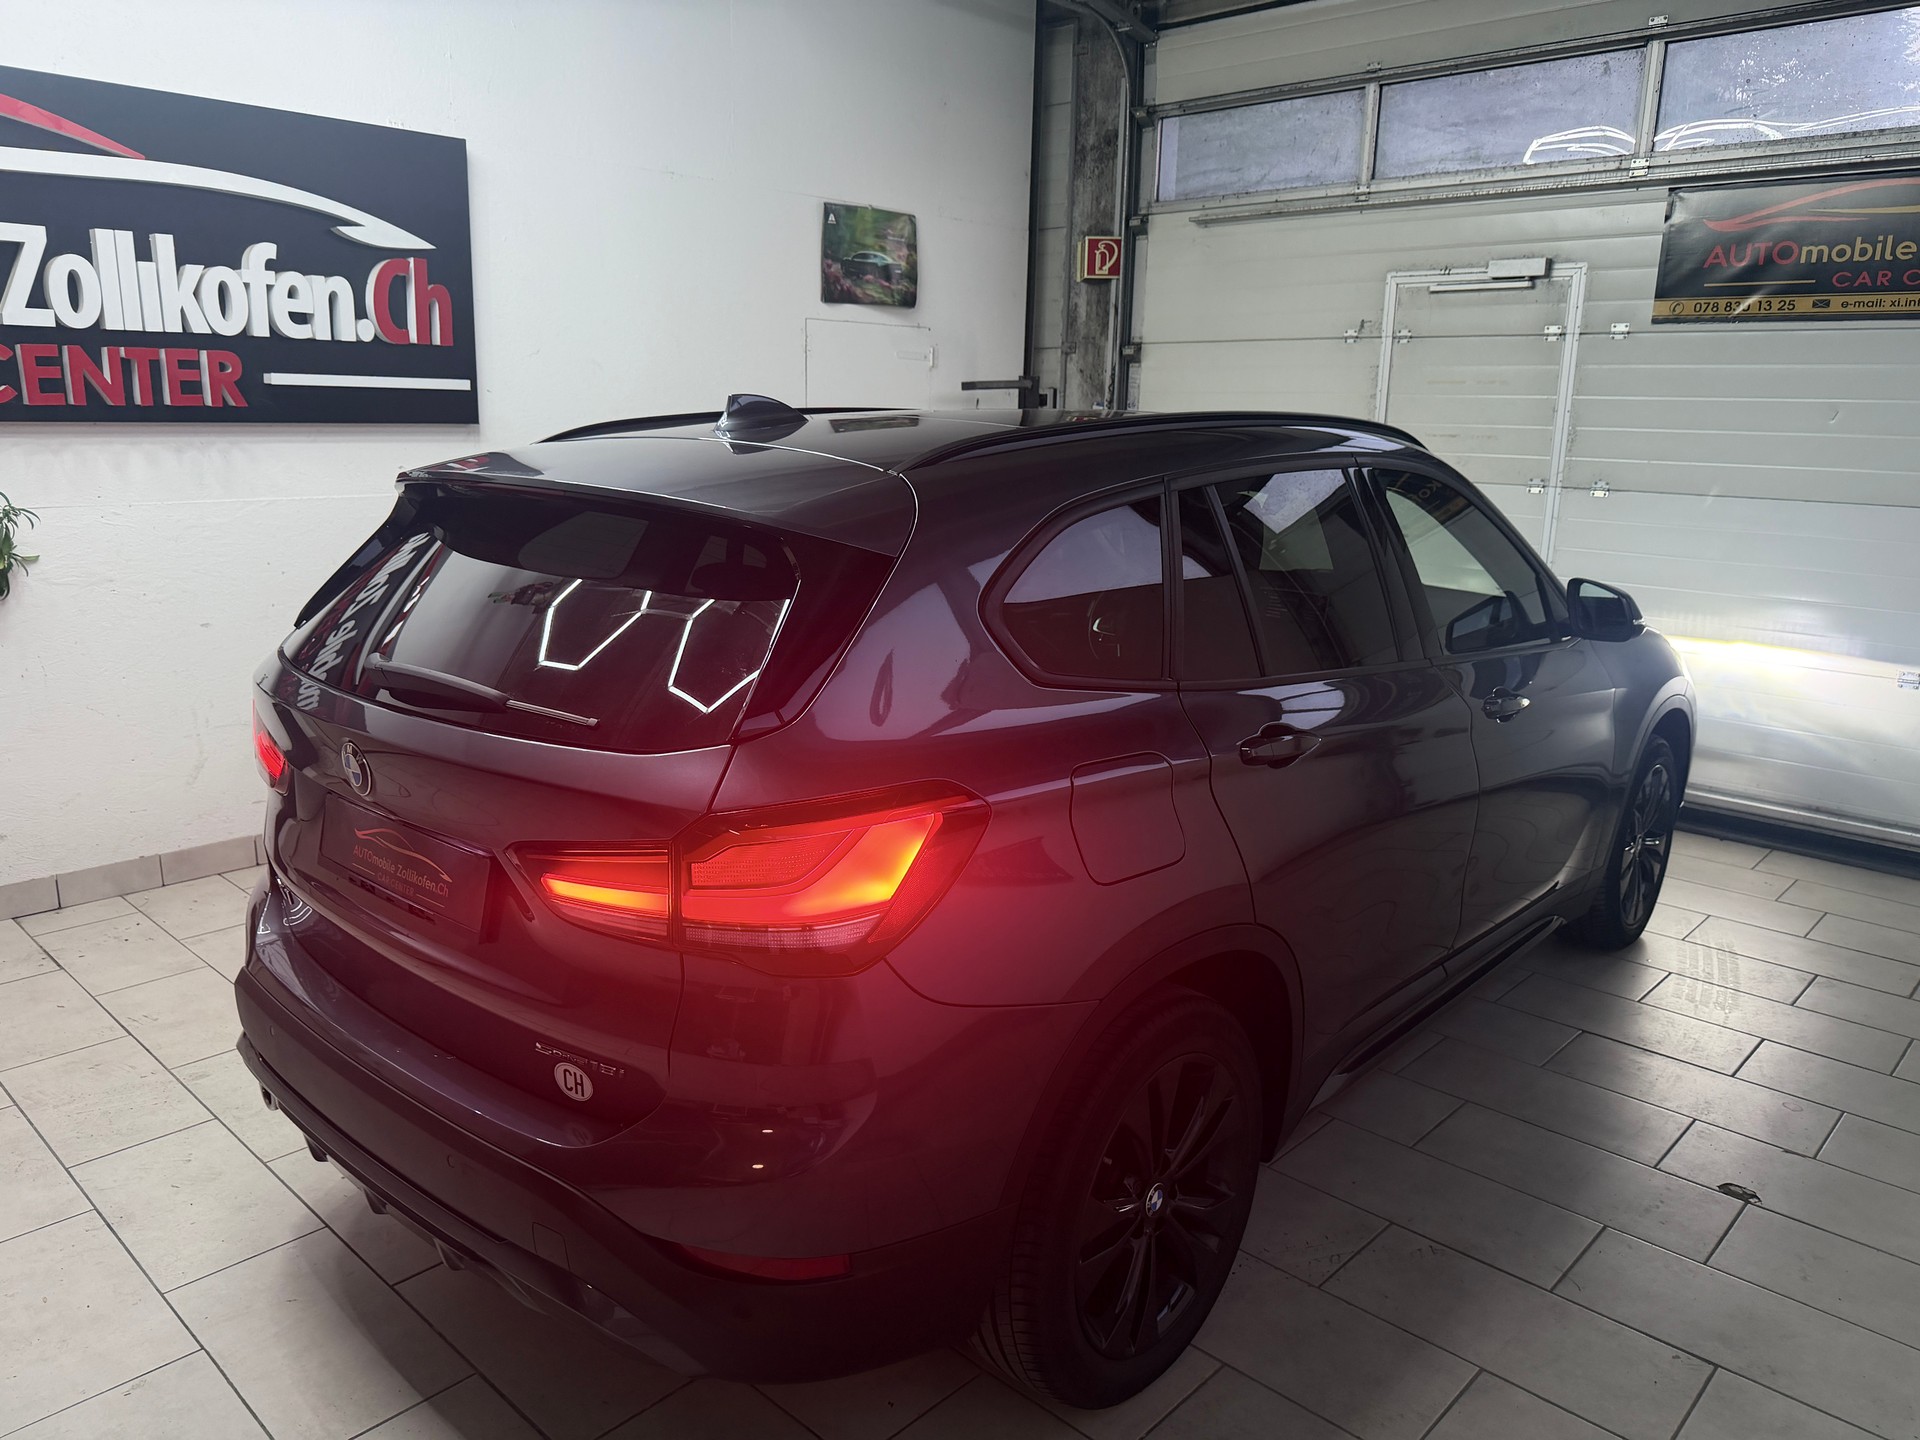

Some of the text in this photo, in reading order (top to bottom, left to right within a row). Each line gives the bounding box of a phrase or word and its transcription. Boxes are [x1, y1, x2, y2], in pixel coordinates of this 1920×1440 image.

[1703, 234, 1918, 270] AUTOmobile
[1831, 270, 1893, 288] CAR
[1693, 301, 1720, 314] 078
[1757, 299, 1773, 312] 13
[1777, 299, 1796, 312] 25
[1840, 298, 1886, 309] e-mail:
[562, 1067, 586, 1098] CH
